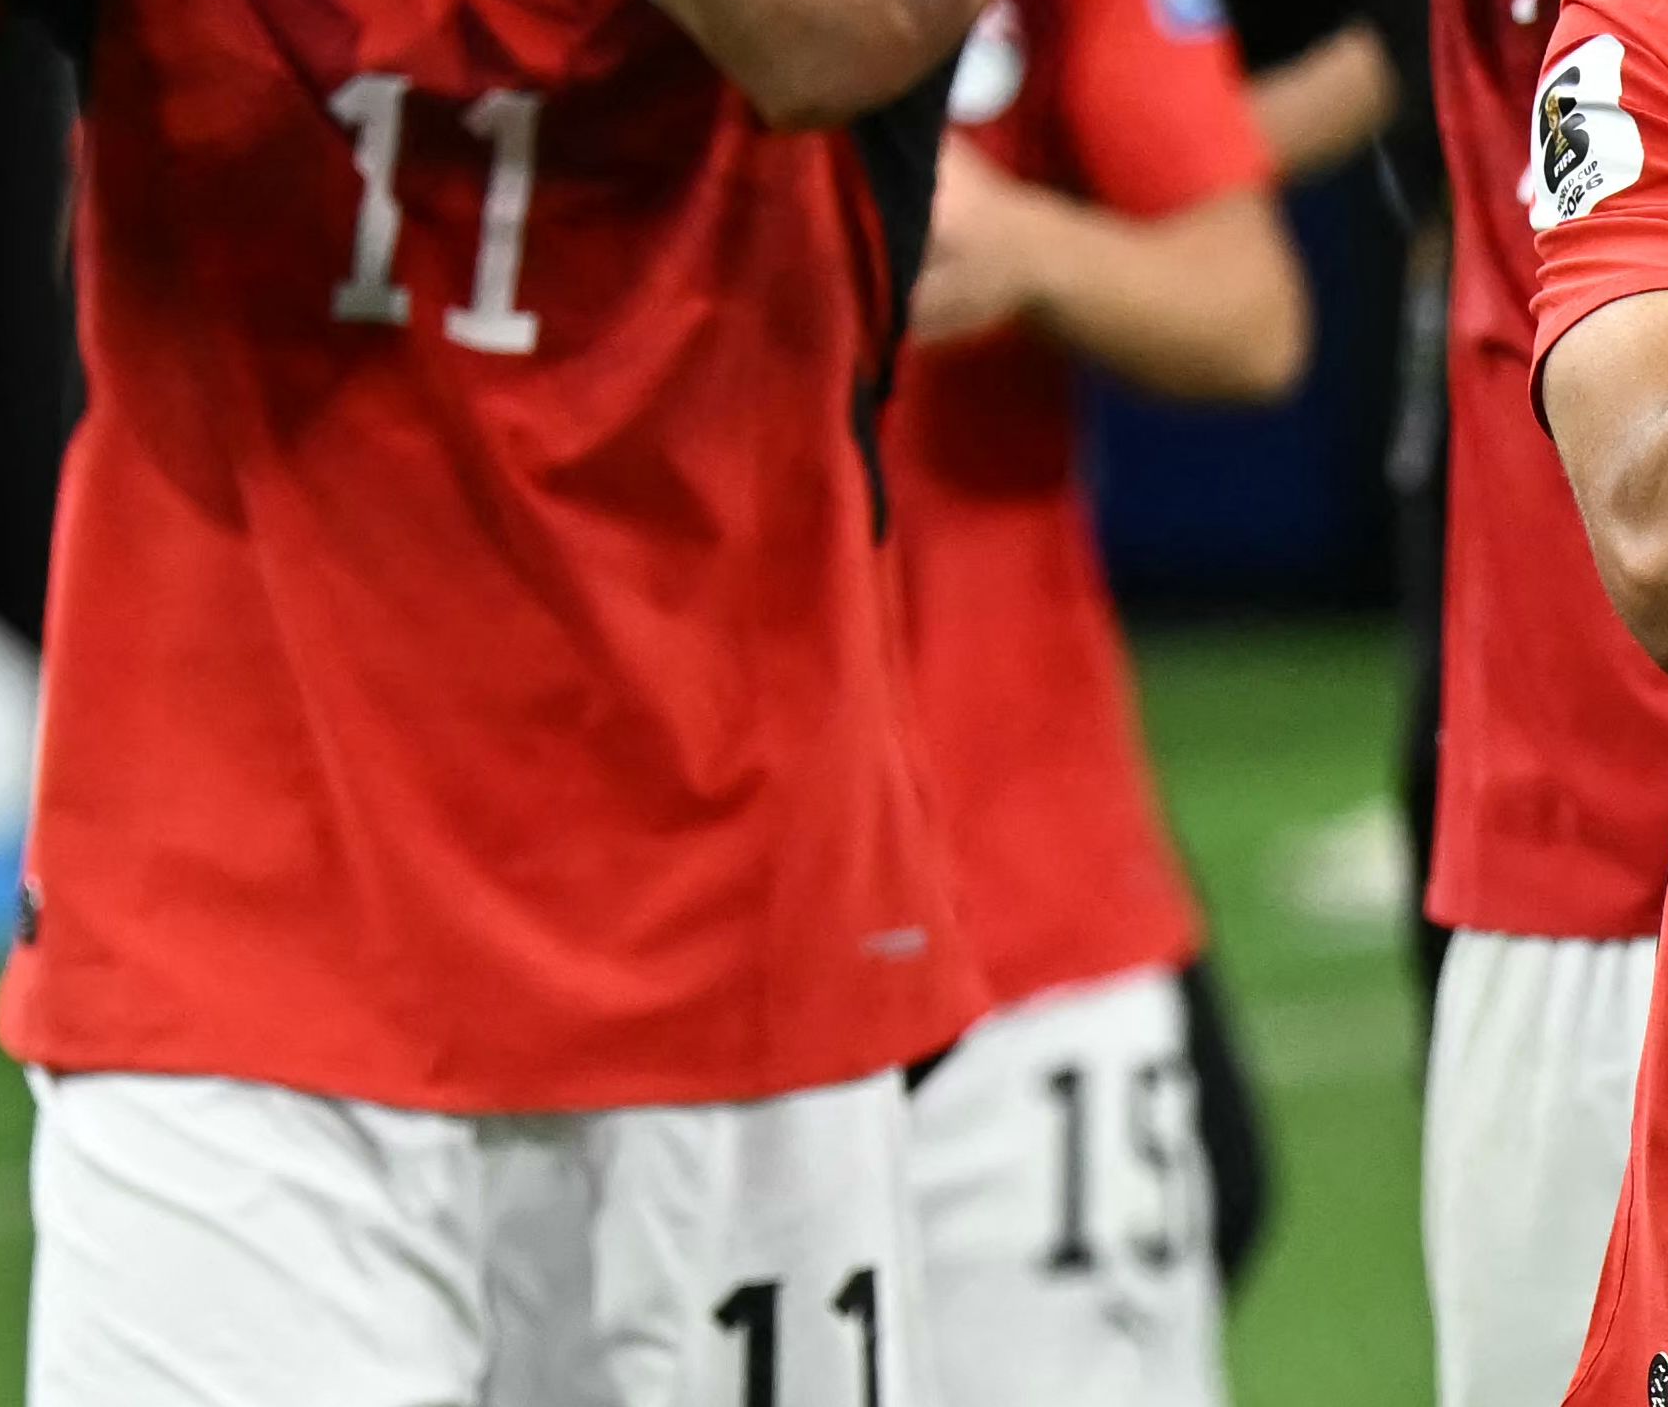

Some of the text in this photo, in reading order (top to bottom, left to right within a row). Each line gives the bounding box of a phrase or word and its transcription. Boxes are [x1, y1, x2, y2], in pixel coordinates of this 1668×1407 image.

[1554, 149, 1577, 178] FIFA
[1578, 160, 1598, 180] CUP
[328, 72, 542, 355] 11
[715, 1267, 878, 1407] 11
